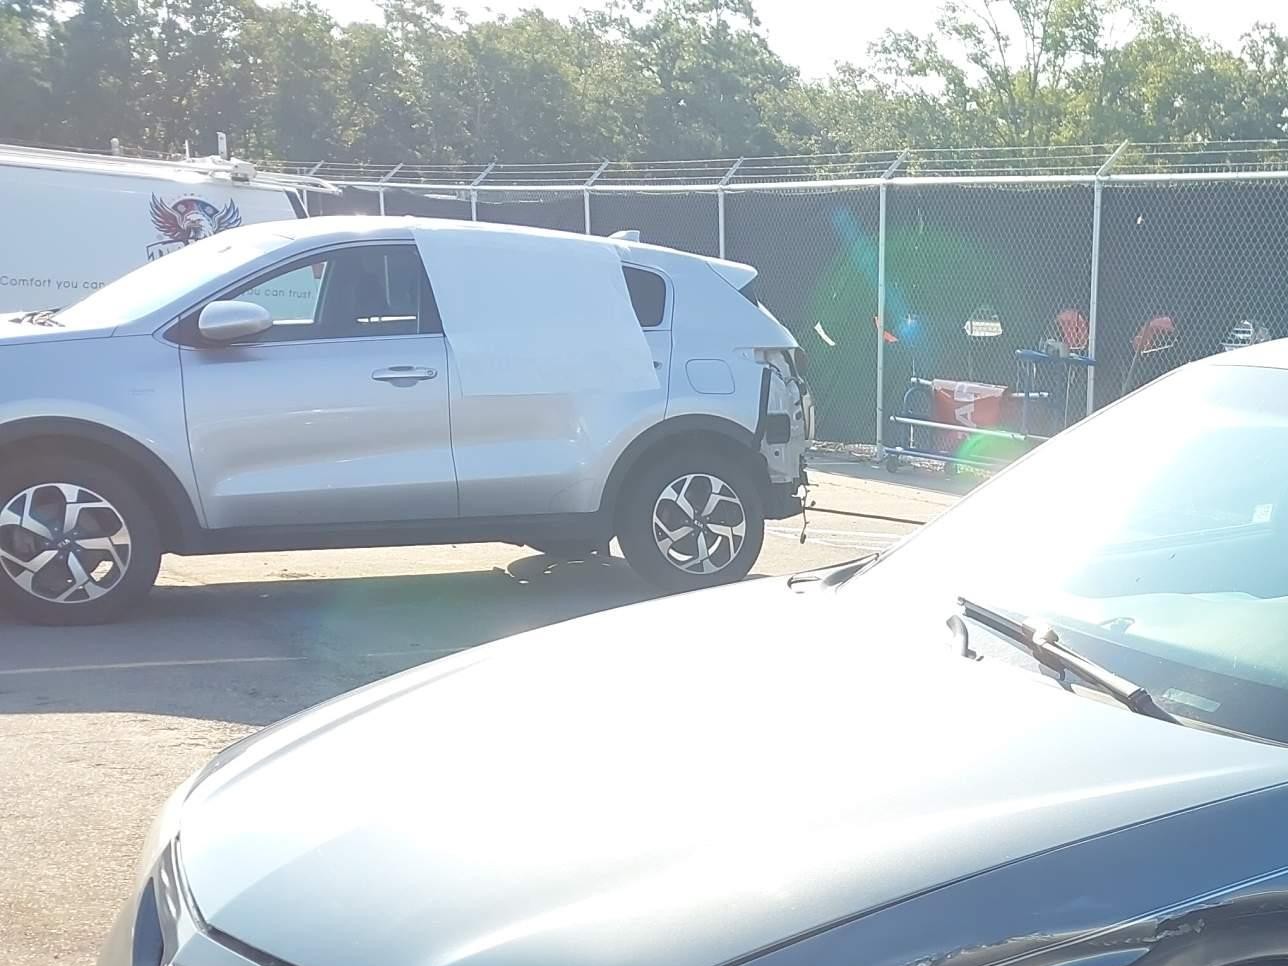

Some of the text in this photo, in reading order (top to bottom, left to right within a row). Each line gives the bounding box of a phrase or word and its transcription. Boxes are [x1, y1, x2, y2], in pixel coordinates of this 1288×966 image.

[0, 275, 51, 288] Comfort
[56, 279, 78, 290] you
[264, 288, 285, 297] can
